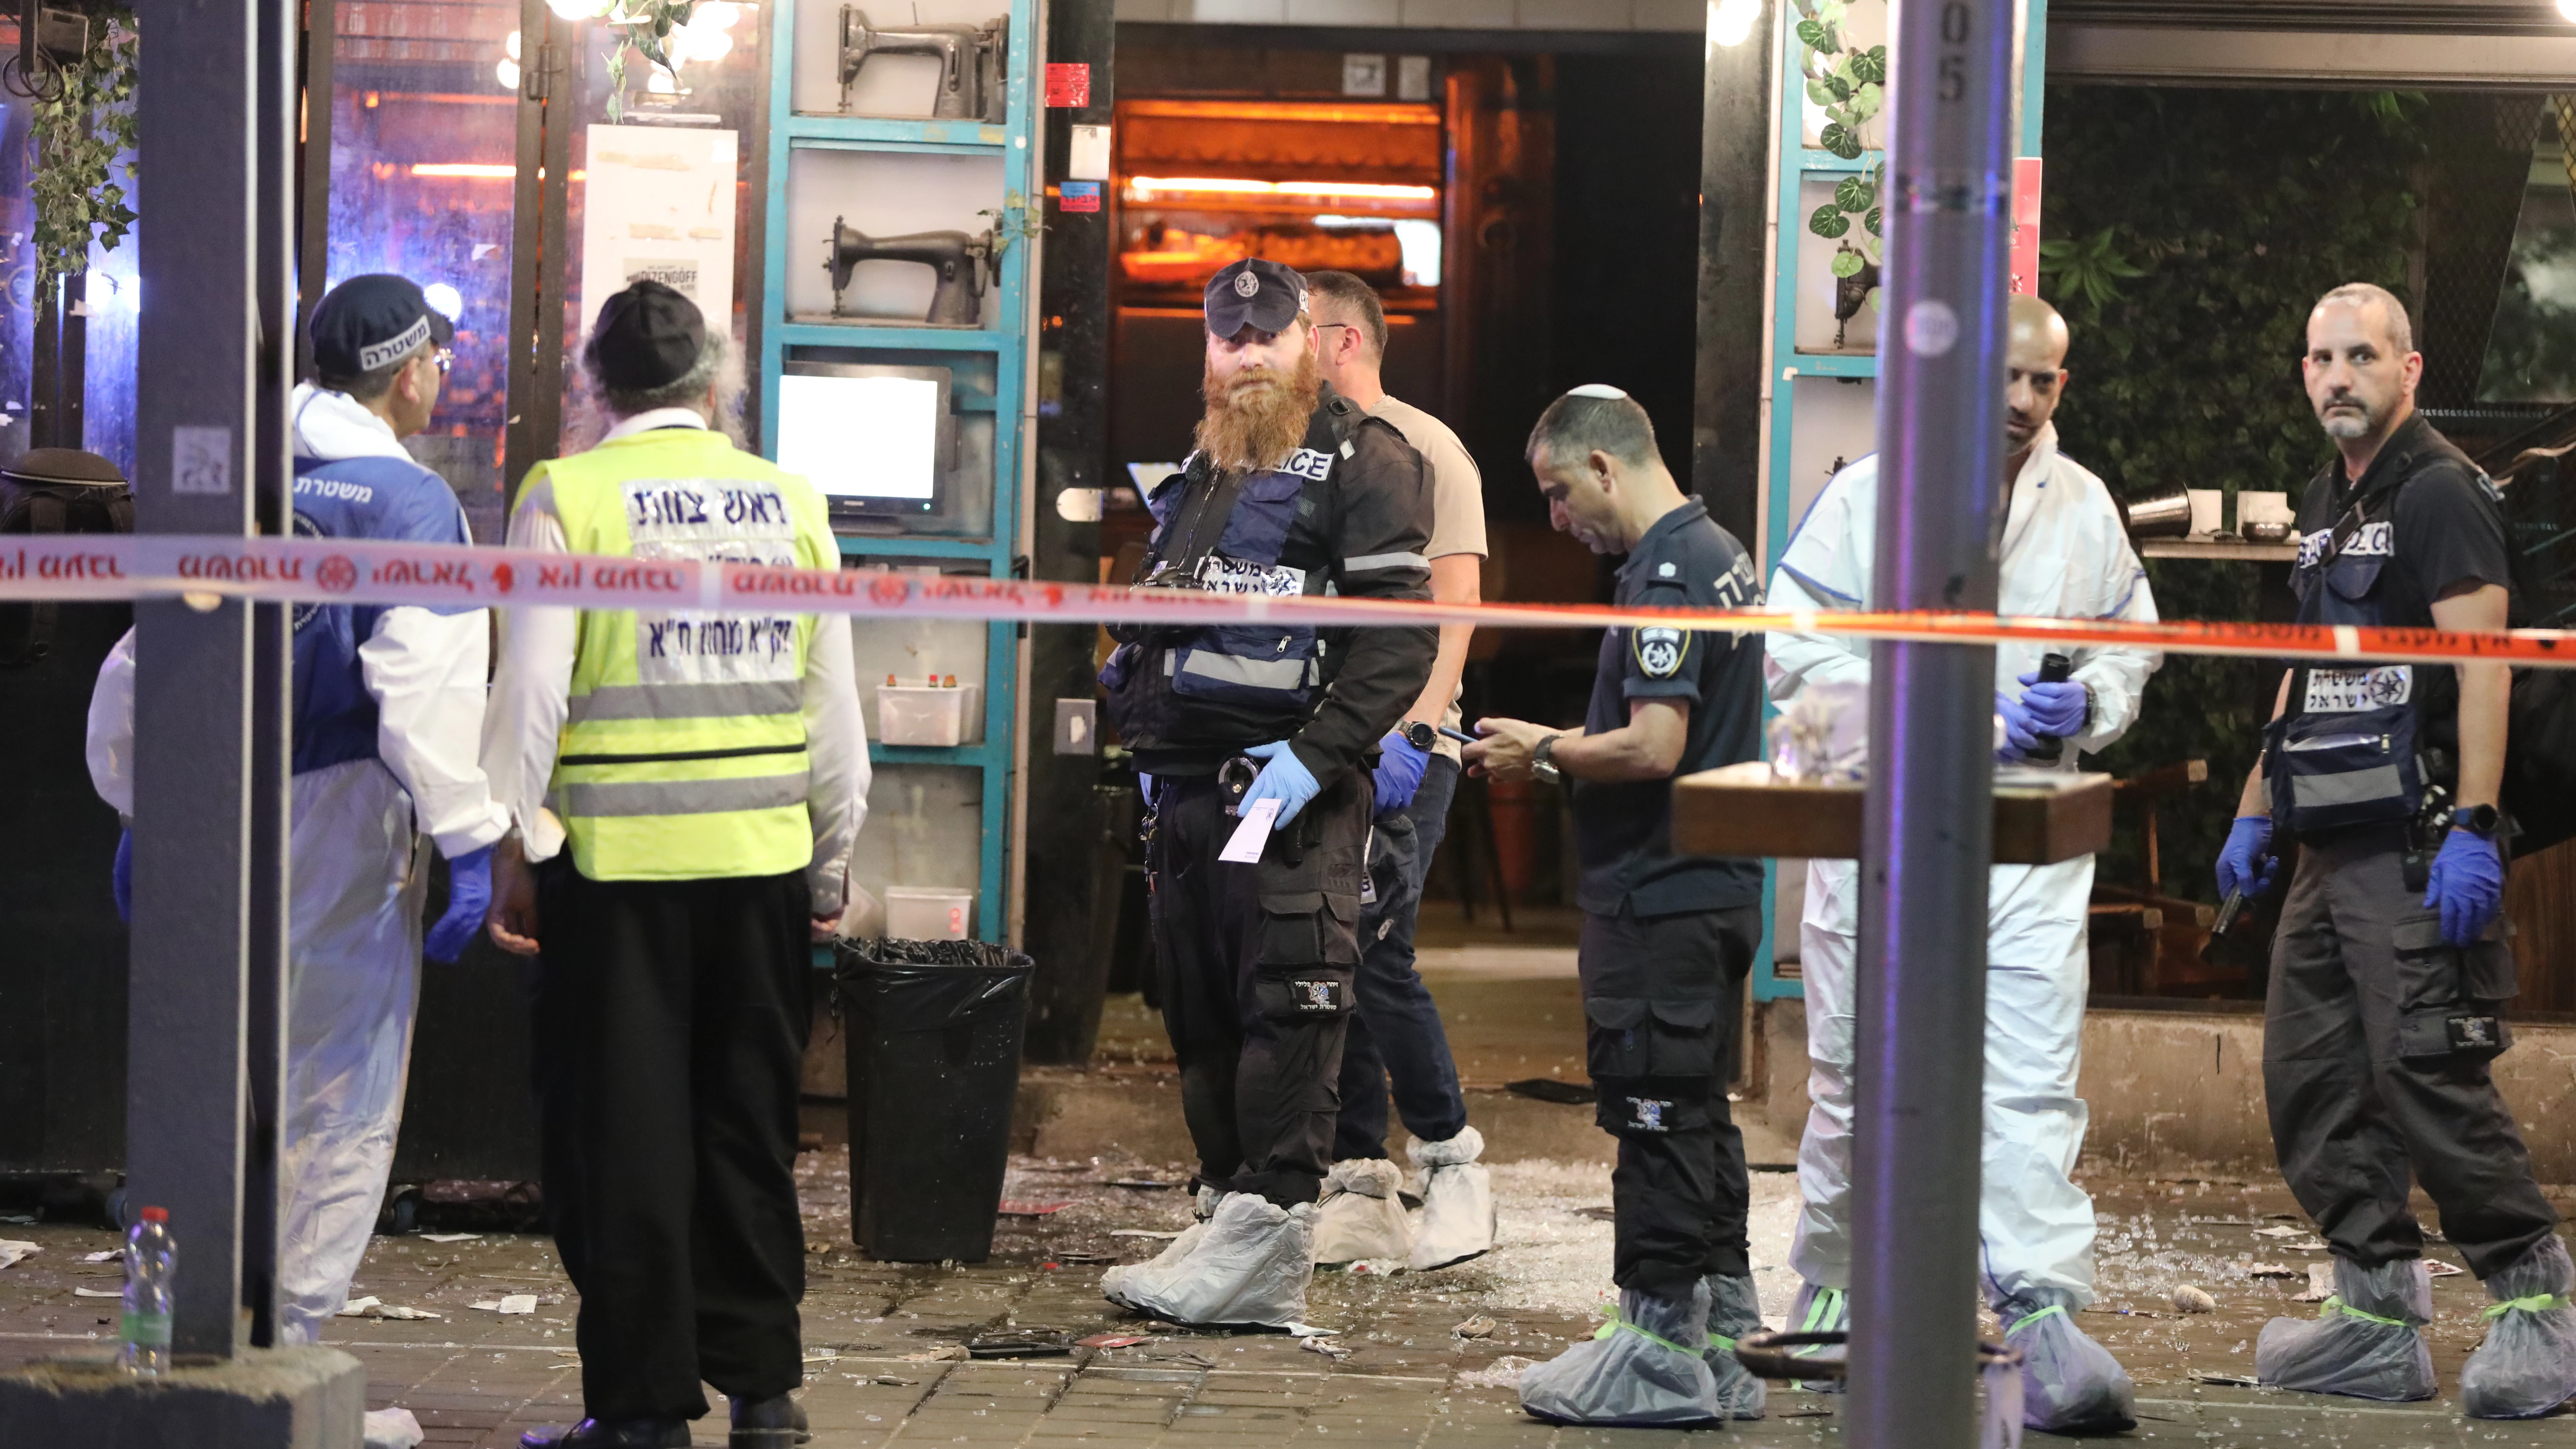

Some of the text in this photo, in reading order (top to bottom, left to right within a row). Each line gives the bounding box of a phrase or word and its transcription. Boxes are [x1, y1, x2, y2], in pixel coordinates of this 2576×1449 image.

[365, 323, 427, 365] משטרה
[294, 477, 373, 504] משטרת
[634, 489, 787, 525] ראש צוות
[38, 553, 126, 580] מעבר
[178, 554, 683, 593] משטרת ישראל אין מעבר
[1208, 560, 1262, 577] משטר
[2310, 693, 2368, 708] ישראל
